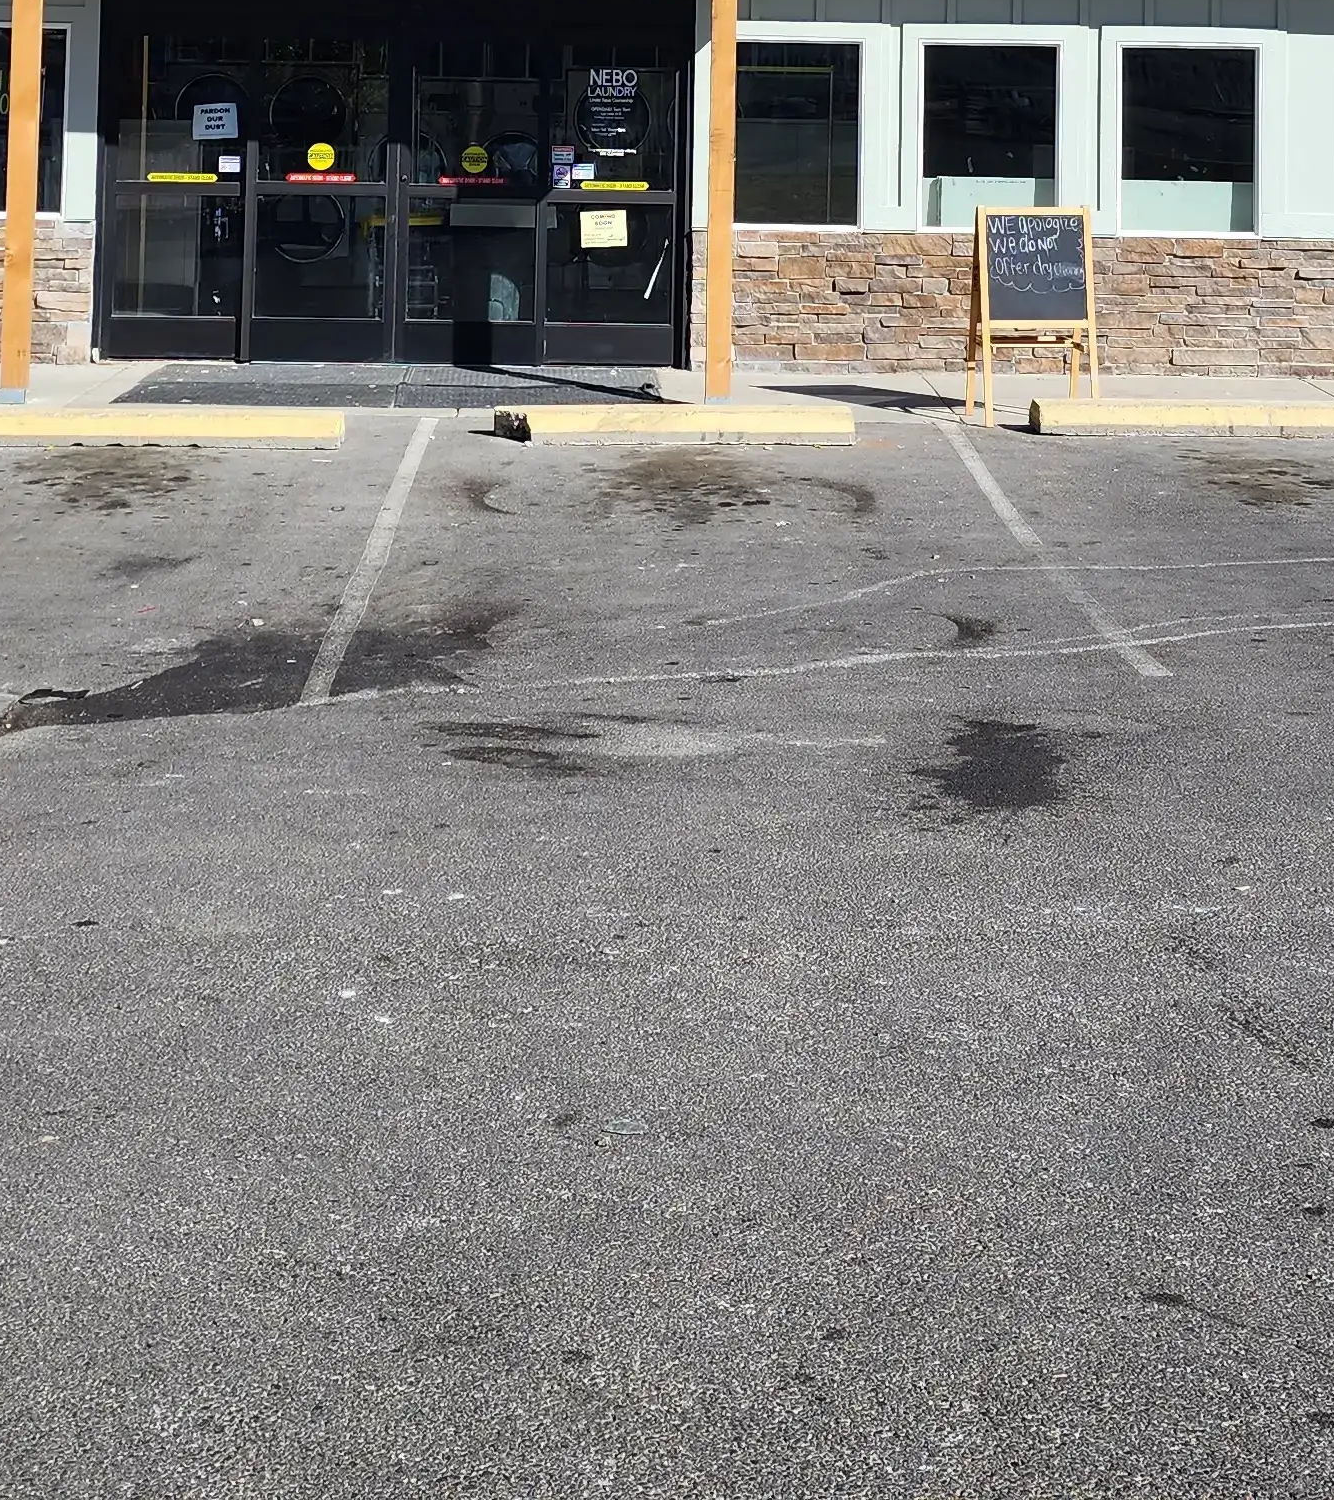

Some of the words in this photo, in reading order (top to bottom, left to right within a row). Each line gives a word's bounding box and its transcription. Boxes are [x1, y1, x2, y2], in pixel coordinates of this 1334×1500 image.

[589, 69, 638, 86] NEBO
[587, 87, 637, 96] LAUNDRY
[987, 216, 1016, 234] WE
[1019, 216, 1078, 238] apologize
[1019, 235, 1036, 253] do
[1033, 254, 1053, 280] dry
